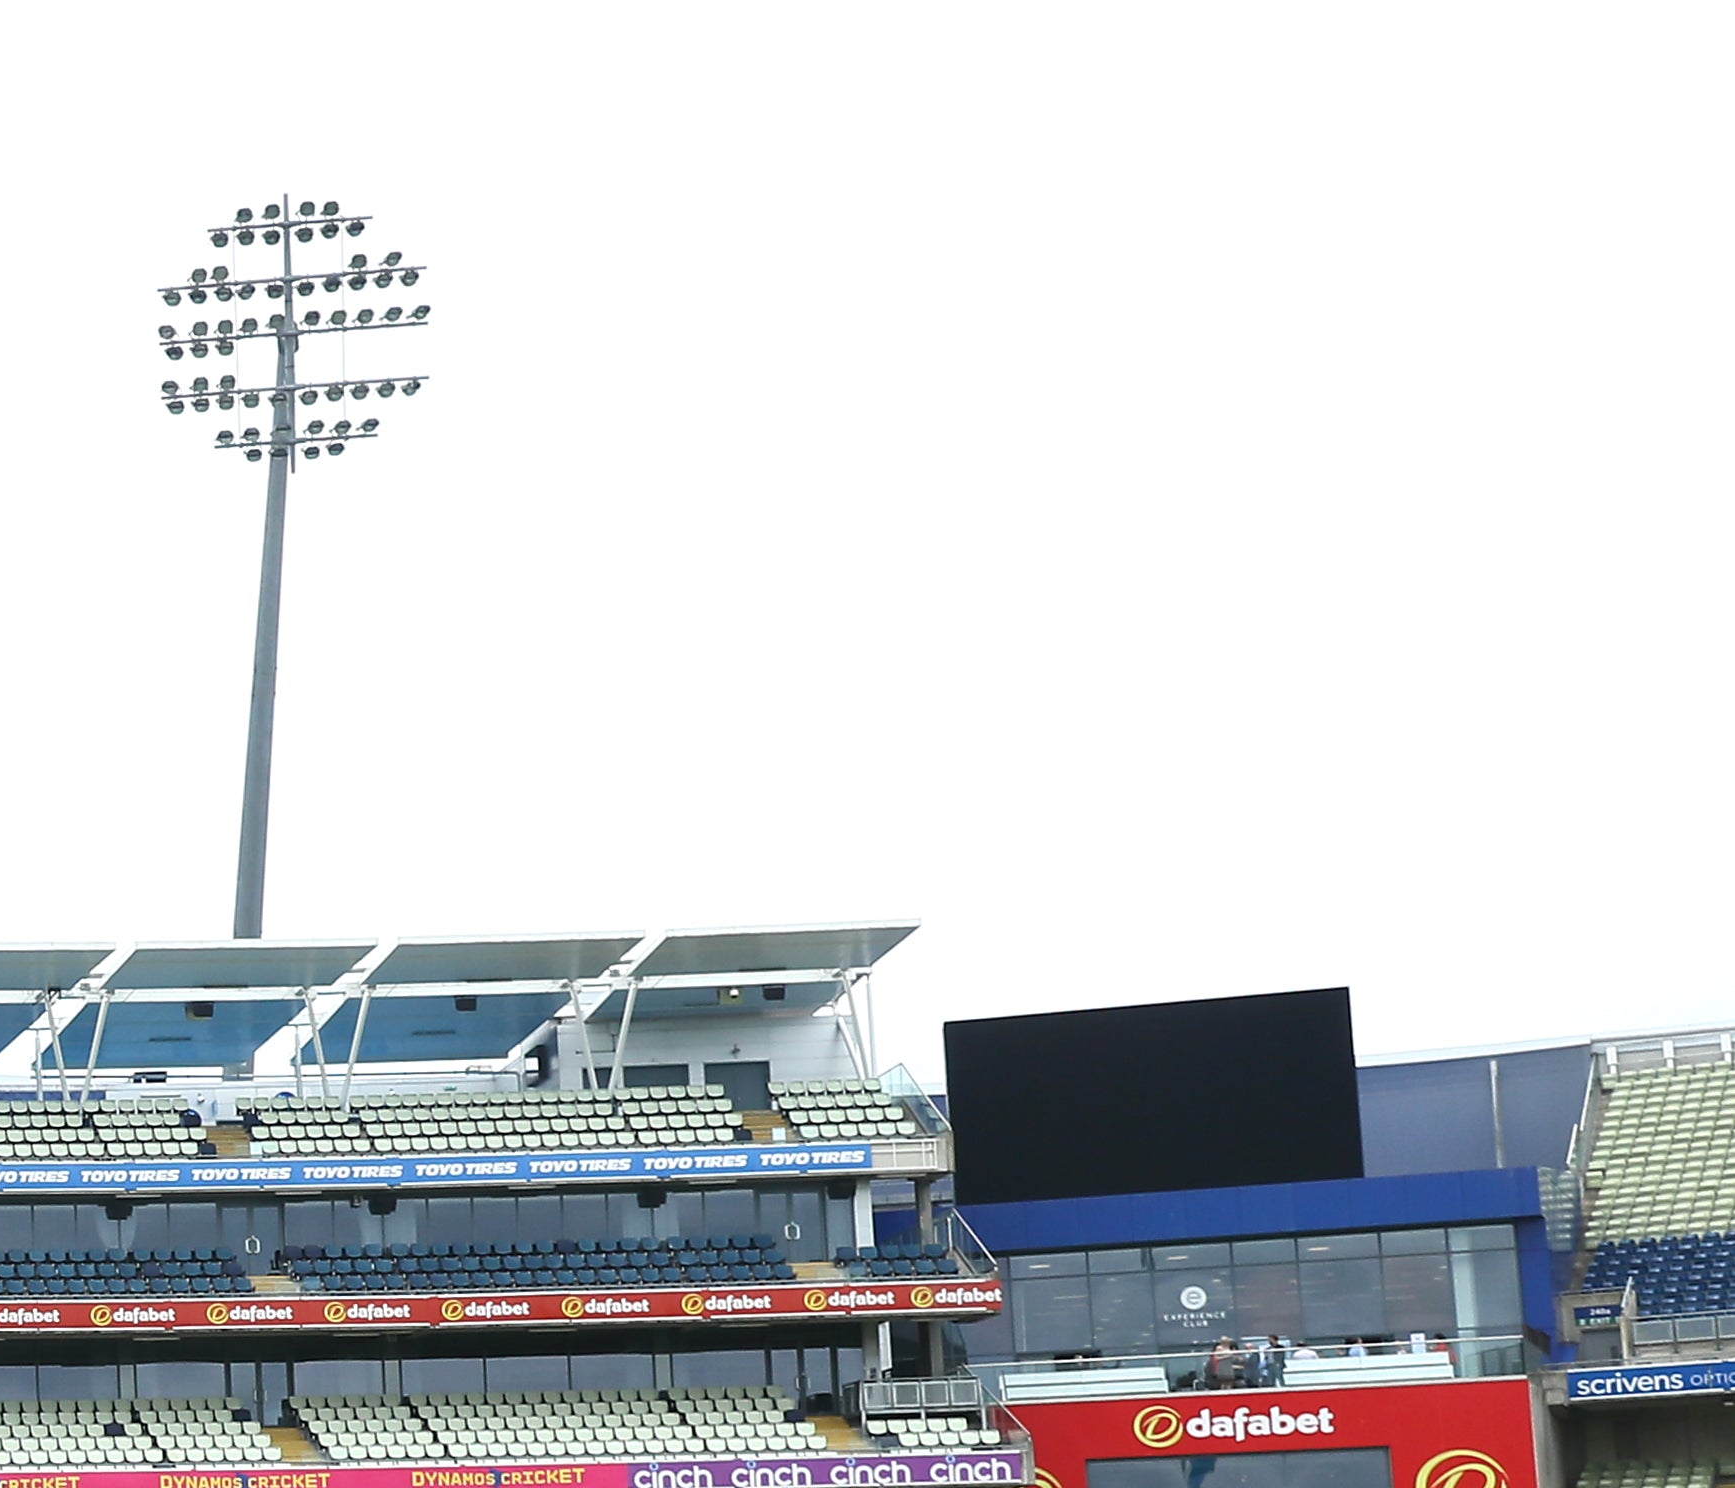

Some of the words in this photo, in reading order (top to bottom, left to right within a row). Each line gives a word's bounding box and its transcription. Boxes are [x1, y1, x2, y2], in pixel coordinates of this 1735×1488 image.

[529, 1159, 578, 1174] TOYO
[578, 1158, 632, 1172] TIRES
[643, 1156, 693, 1170] TOYO
[693, 1154, 749, 1169] TIRES
[759, 1152, 811, 1166] TOYO
[810, 1150, 866, 1165] TIRES
[18, 1170, 70, 1183] TIRES
[80, 1170, 128, 1183] TOYO
[128, 1169, 181, 1182] TIRES
[191, 1167, 240, 1181] TOYO
[240, 1167, 292, 1180] TIRES
[302, 1166, 351, 1179] TOYO
[351, 1165, 404, 1179] TIRES
[415, 1163, 464, 1177] TOYO
[464, 1161, 518, 1175] TIRES
[704, 1294, 772, 1313] dafabet
[827, 1290, 895, 1309] dafabet
[934, 1287, 1003, 1306] dafabet
[112, 1306, 176, 1325] dafabet
[229, 1304, 293, 1323] dafabet
[346, 1303, 411, 1321] dafabet
[464, 1300, 530, 1319] dafabet
[584, 1297, 650, 1316] dafabet
[1163, 1311, 1226, 1322] EXPERIENCE
[1183, 1320, 1209, 1328] CLUB
[1577, 1371, 1684, 1396] scrivens
[1186, 1406, 1335, 1442] dafabet
[411, 1471, 496, 1487] DYNAMOS
[500, 1467, 586, 1485] CRICKET
[731, 1460, 812, 1488] cinch
[829, 1457, 912, 1487] cinch
[929, 1454, 1012, 1483] cinch
